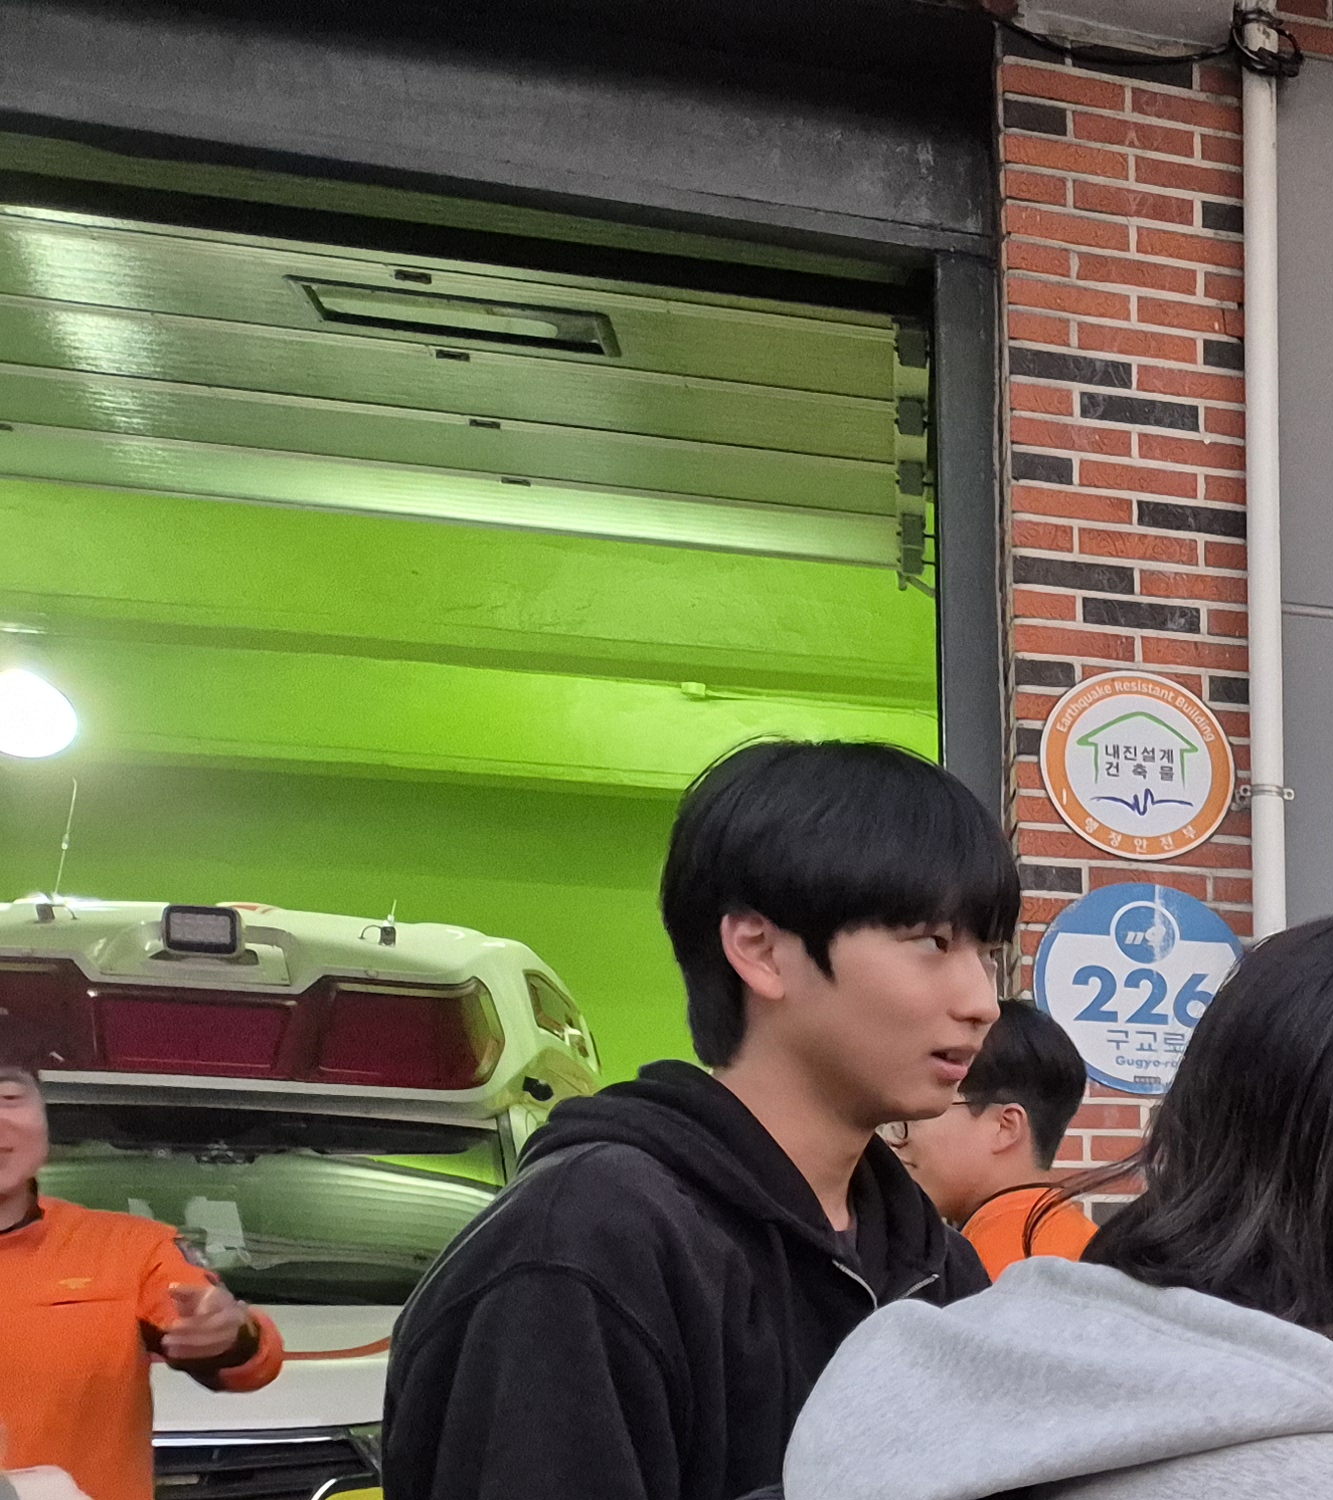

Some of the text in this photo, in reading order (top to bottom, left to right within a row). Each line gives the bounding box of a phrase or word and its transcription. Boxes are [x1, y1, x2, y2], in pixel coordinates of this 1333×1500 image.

[1056, 680, 1216, 743] Earthquake Resistant Building
[1104, 744, 1175, 765] 내진설계
[1071, 964, 1215, 1029] 226
